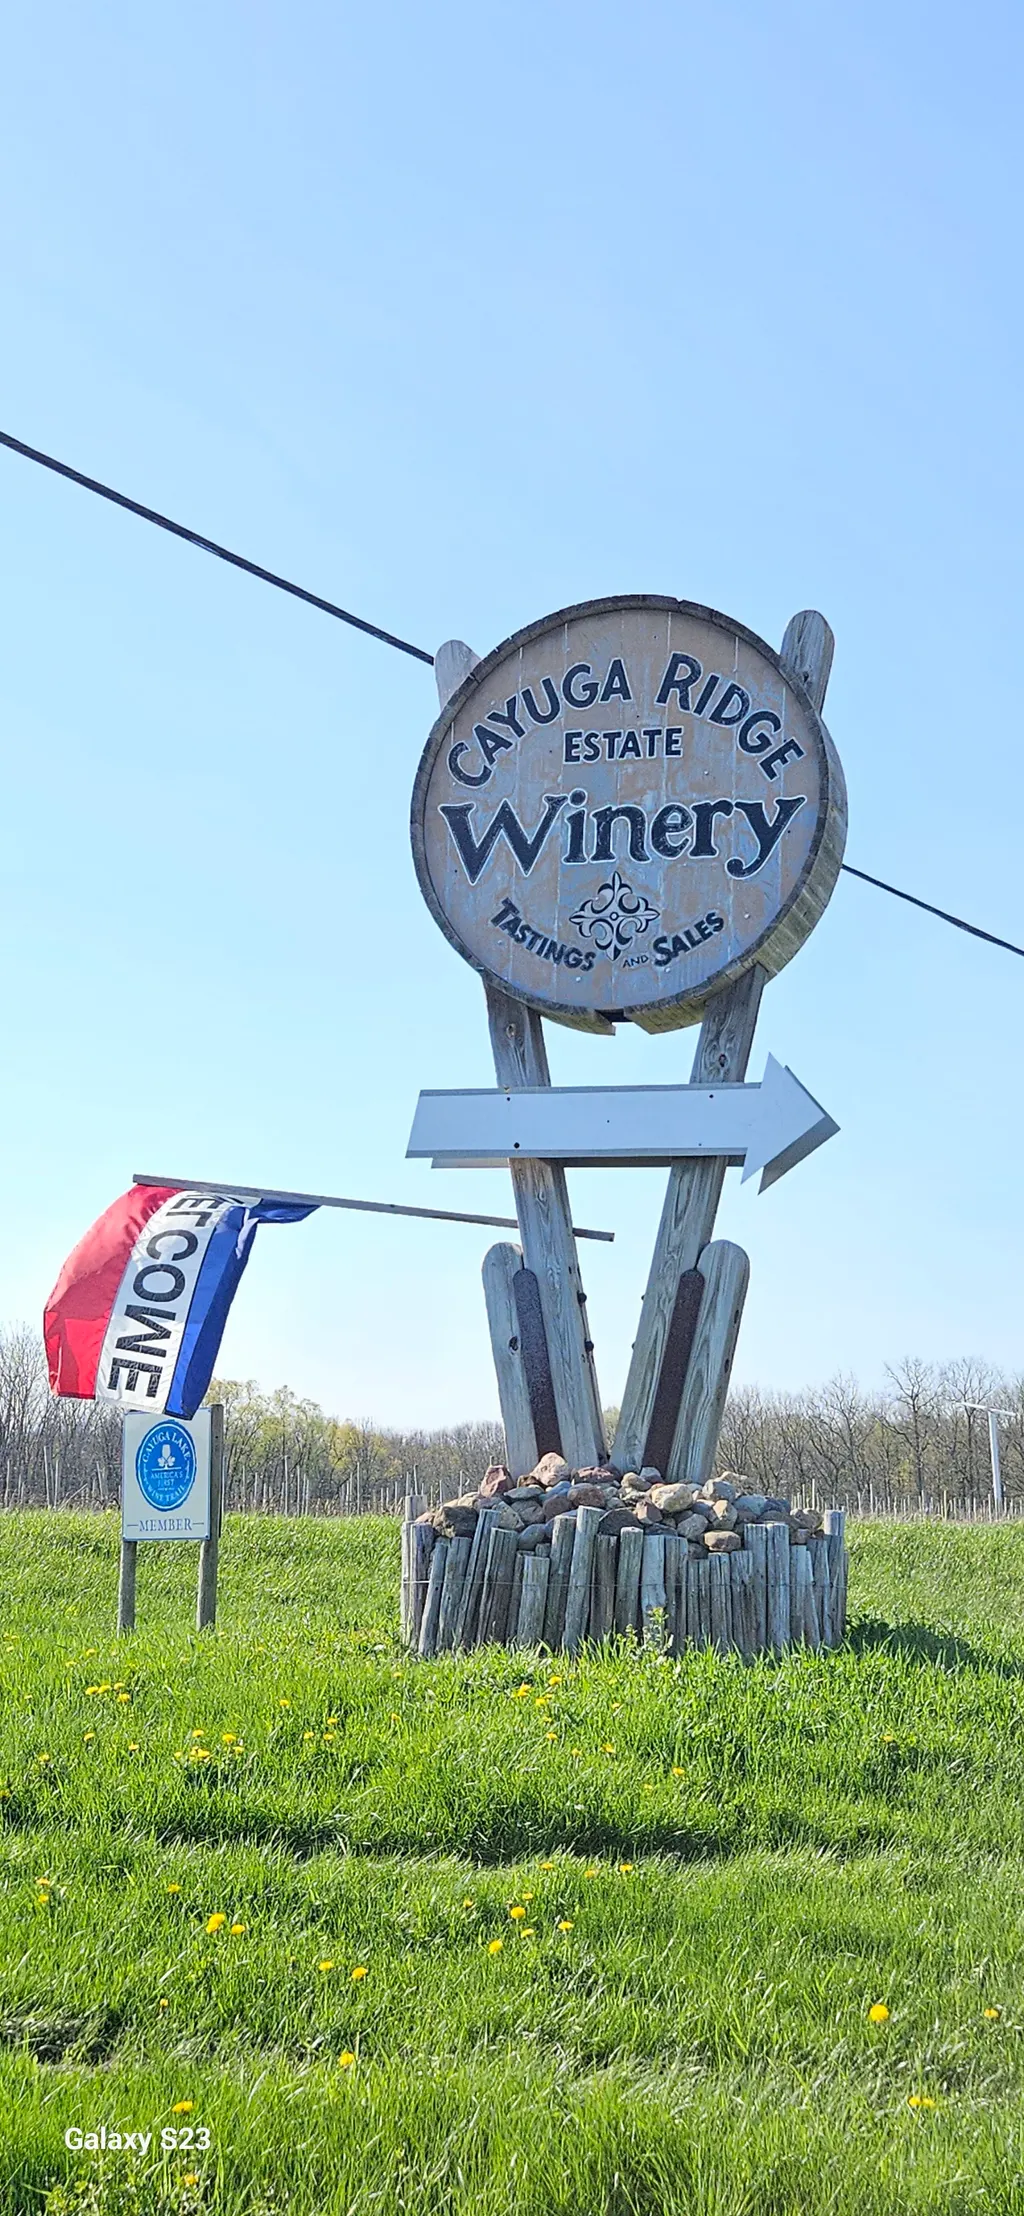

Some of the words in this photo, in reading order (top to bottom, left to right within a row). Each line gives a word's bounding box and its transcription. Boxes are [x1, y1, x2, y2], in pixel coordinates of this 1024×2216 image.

[447, 657, 633, 789] CAYUGA
[655, 651, 806, 781] RIDGE
[563, 726, 685, 765] ESTATE
[438, 787, 808, 886] Winery
[489, 897, 597, 972] TASTINGS
[622, 953, 650, 969] AND
[652, 911, 725, 968] SALES
[142, 1431, 171, 1463] CAYUGA
[171, 1431, 191, 1461] LAKE
[139, 1518, 193, 1532] MEMBER
